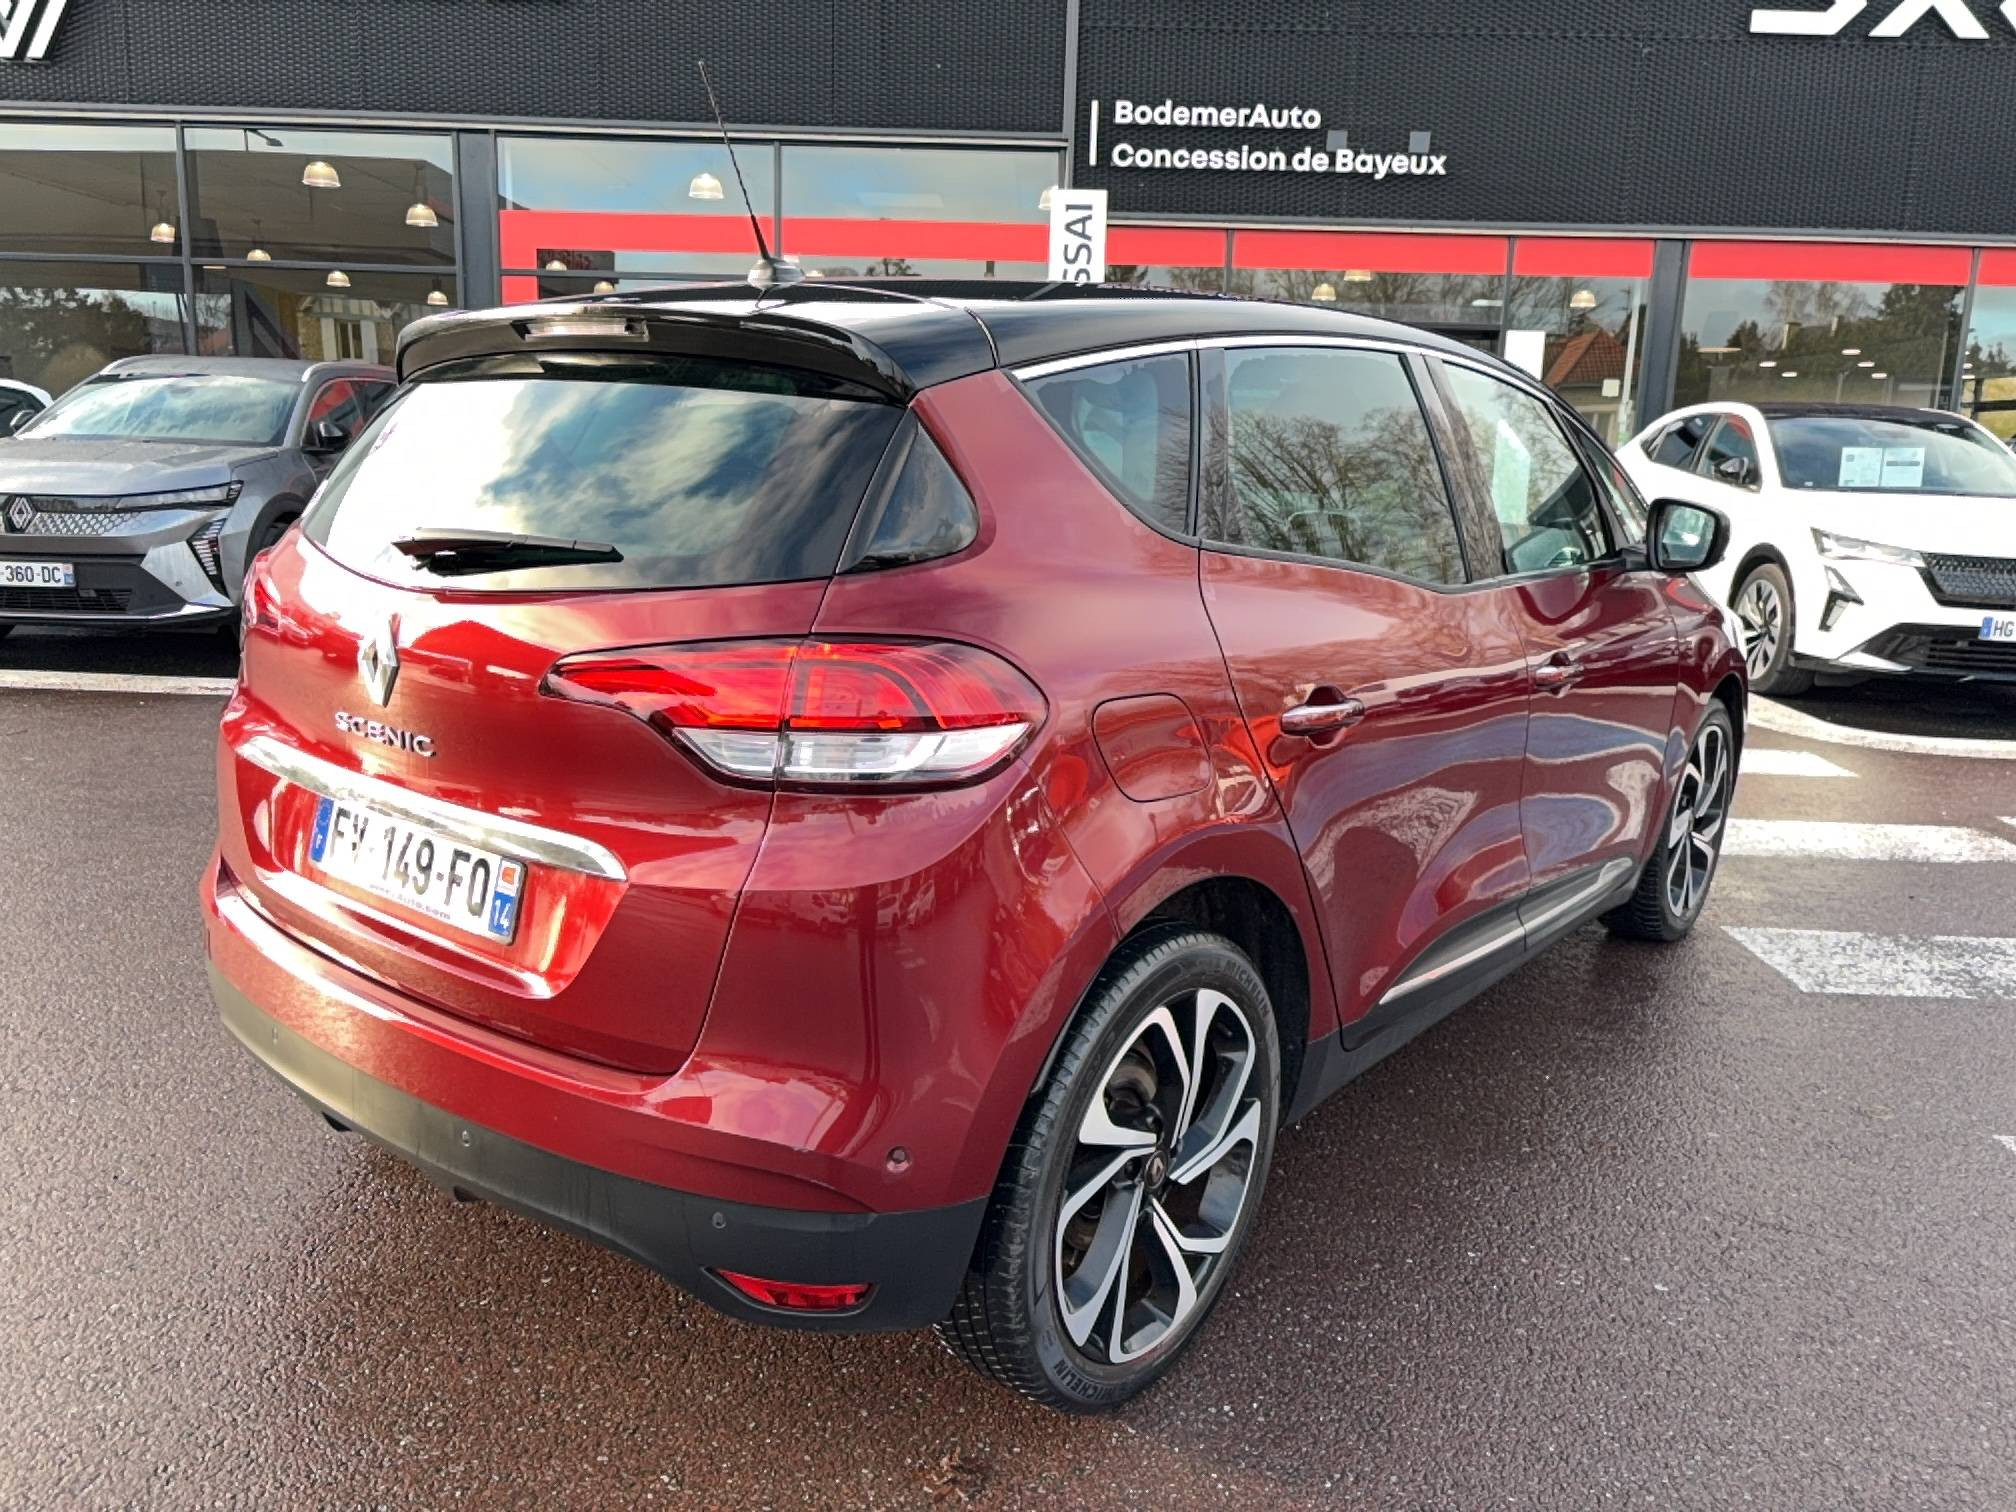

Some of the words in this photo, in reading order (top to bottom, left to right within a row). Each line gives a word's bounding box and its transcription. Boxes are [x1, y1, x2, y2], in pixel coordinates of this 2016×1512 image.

[1114, 99, 1322, 129] BodemerAuto
[1111, 143, 1286, 172] Concession
[1291, 146, 1330, 172] de
[1335, 150, 1447, 179] Bayeux
[1993, 619, 2015, 637] HG
[335, 711, 436, 757] SCENIC
[493, 899, 512, 930] 14
